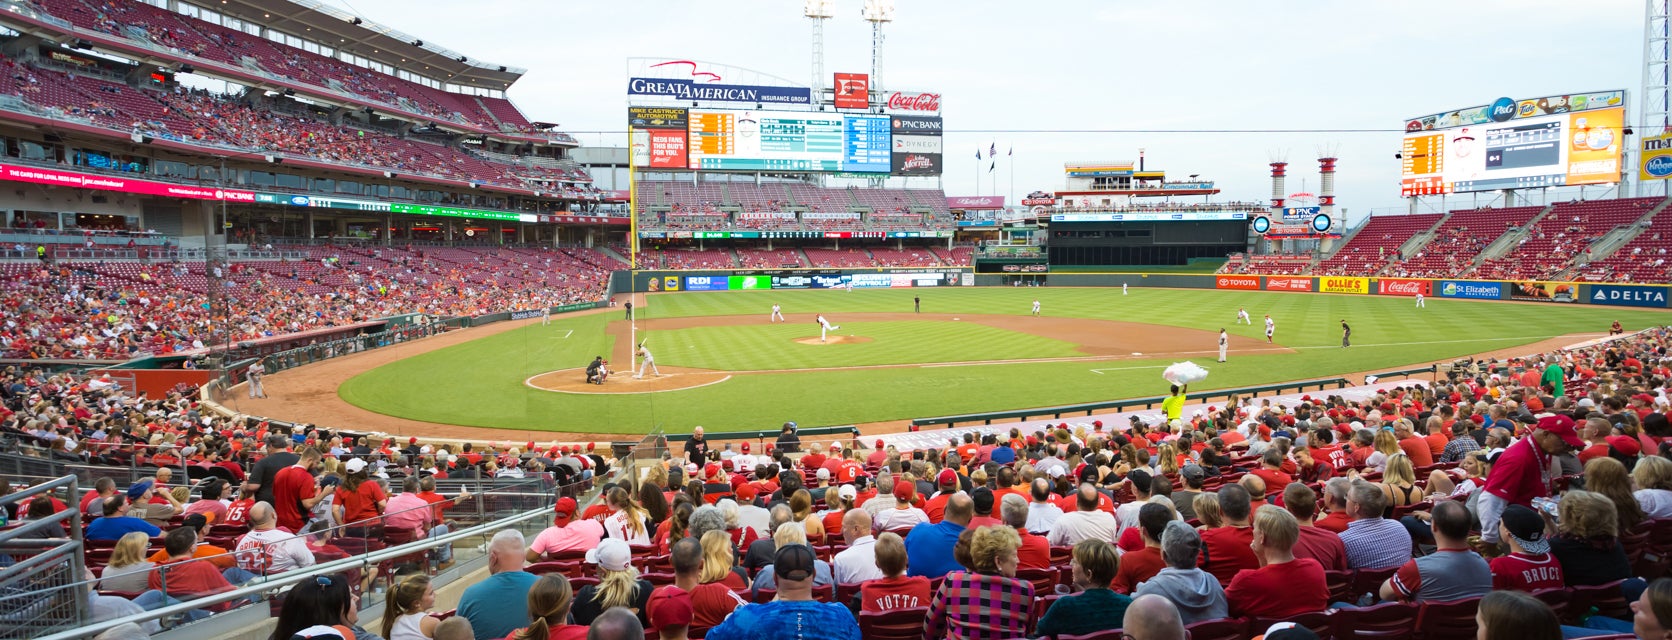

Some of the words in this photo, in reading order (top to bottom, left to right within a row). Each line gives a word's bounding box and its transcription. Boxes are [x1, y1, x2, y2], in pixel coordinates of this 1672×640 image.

[1494, 104, 1514, 116] P&G
[688, 277, 711, 285] RDI
[1465, 285, 1499, 294] Elizabeth
[1610, 290, 1664, 302] DELTA
[227, 507, 245, 521] 15
[1522, 566, 1560, 584] BRUCE
[876, 594, 918, 610] VOTTO
